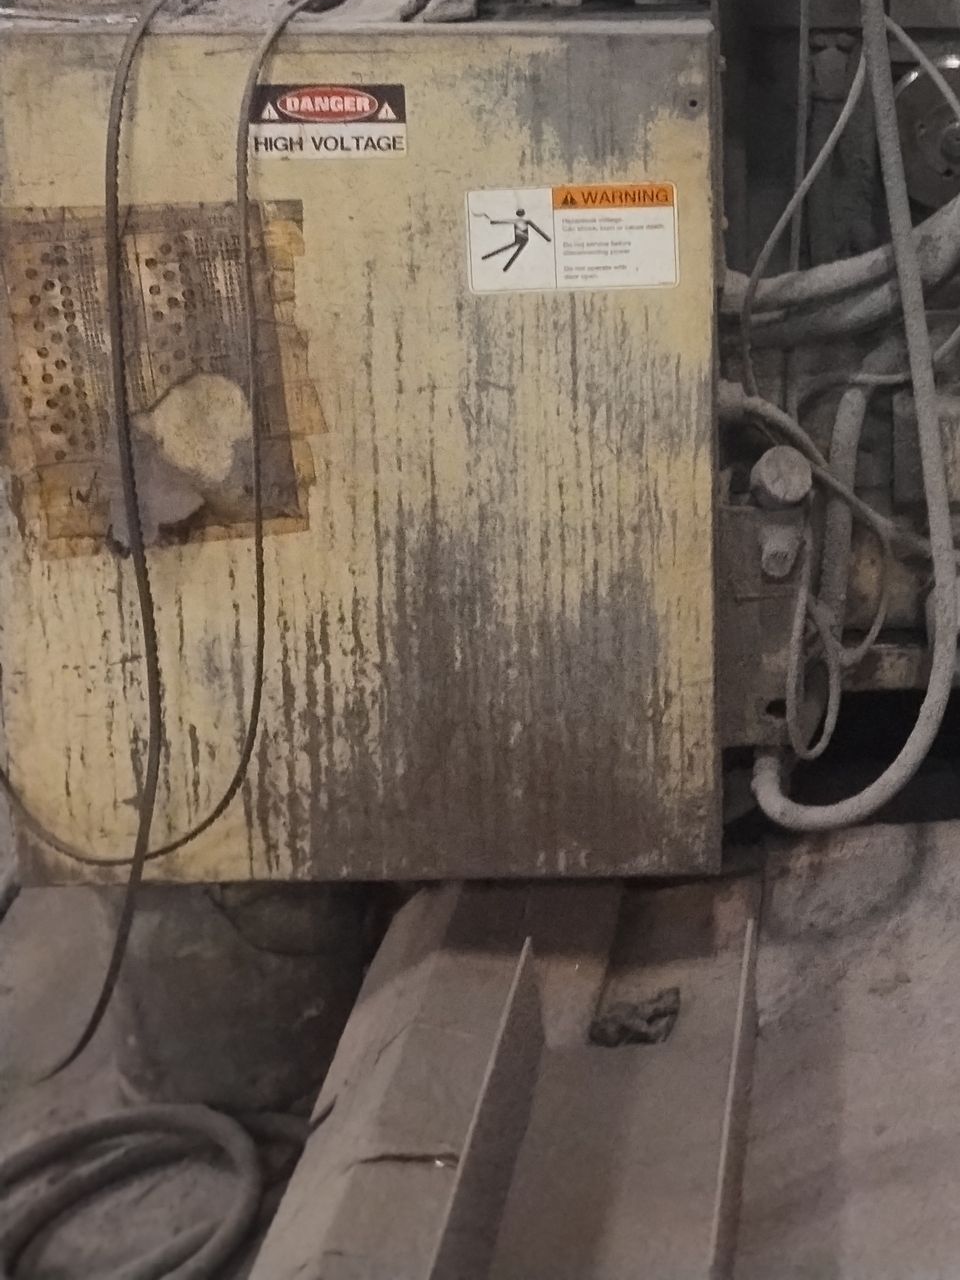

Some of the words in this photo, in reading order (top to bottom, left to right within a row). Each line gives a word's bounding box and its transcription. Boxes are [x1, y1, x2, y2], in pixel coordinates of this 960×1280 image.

[286, 95, 370, 112] DANGER
[254, 135, 304, 152] HIGH
[311, 135, 405, 152] VOLTAGE
[581, 188, 669, 205] WARNING
